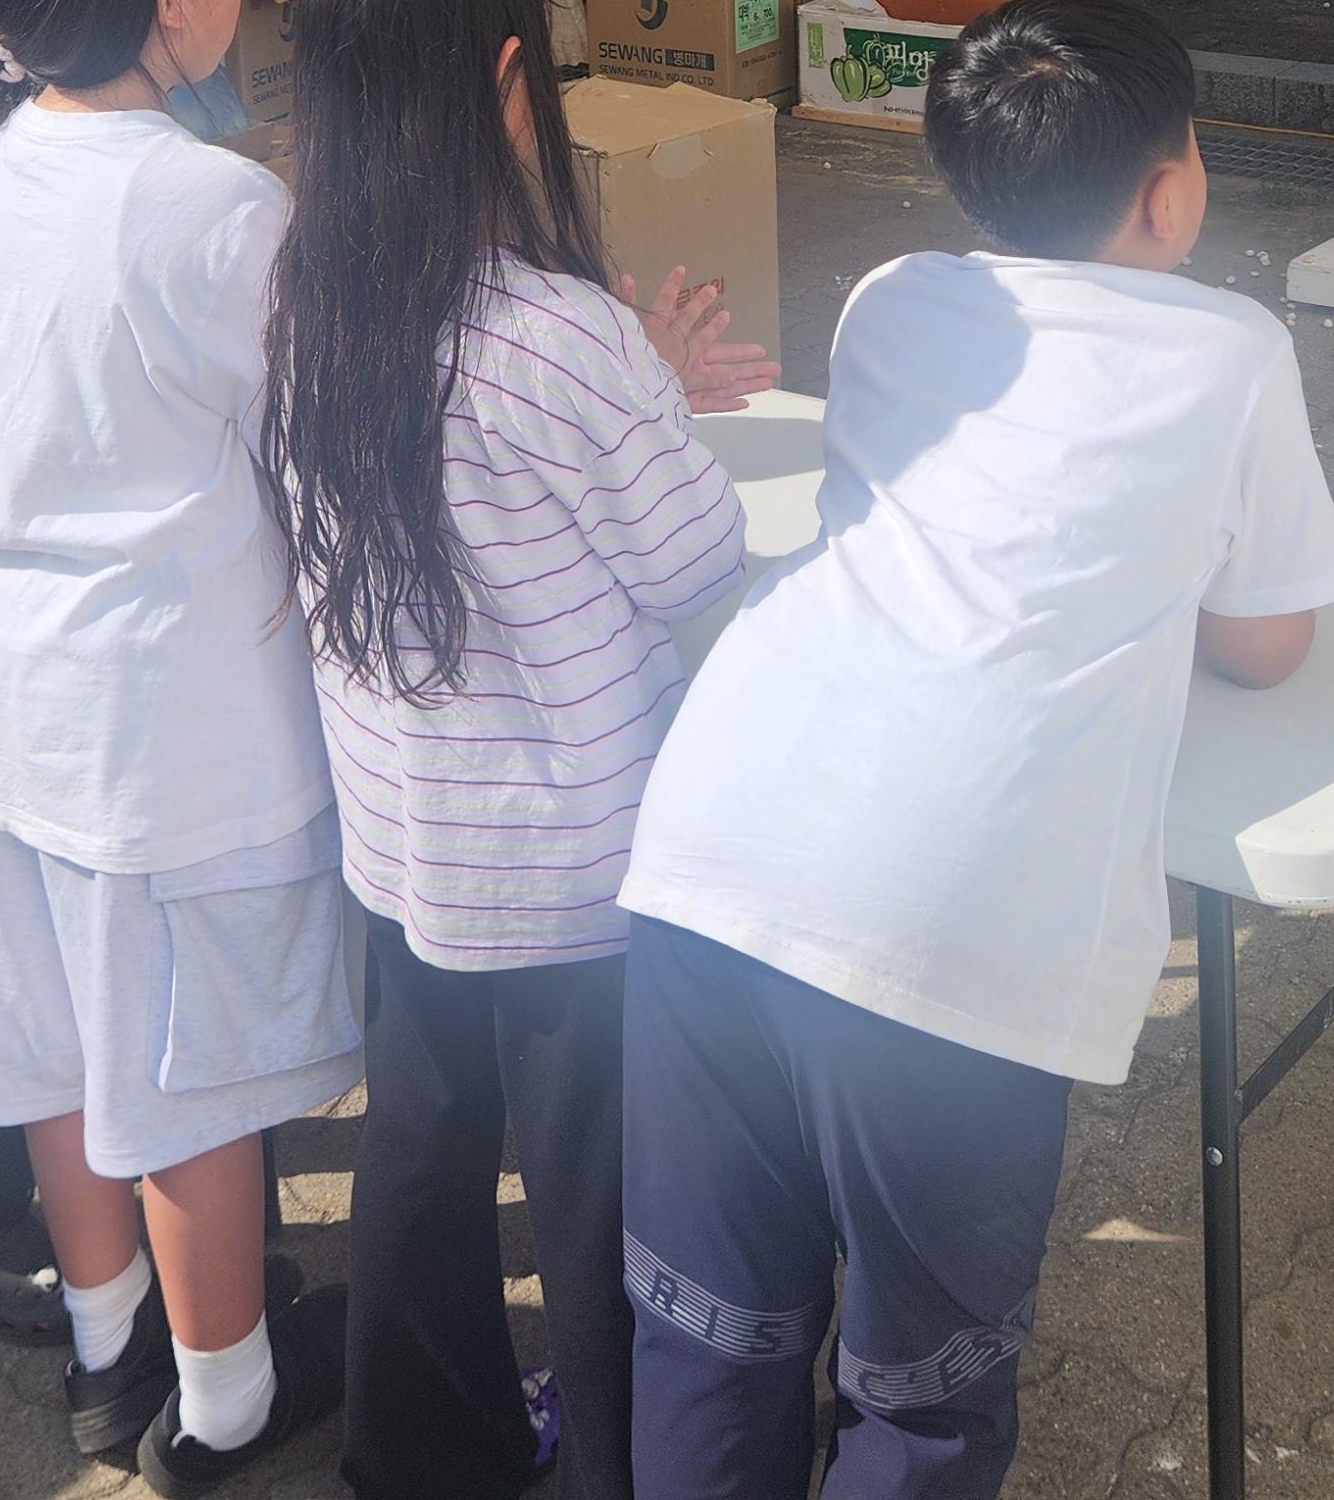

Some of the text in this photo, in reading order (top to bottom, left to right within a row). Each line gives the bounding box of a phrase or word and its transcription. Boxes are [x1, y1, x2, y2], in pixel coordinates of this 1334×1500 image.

[599, 42, 662, 65] SEWANG
[599, 64, 633, 77] SEWANG
[636, 68, 663, 81] METAL
